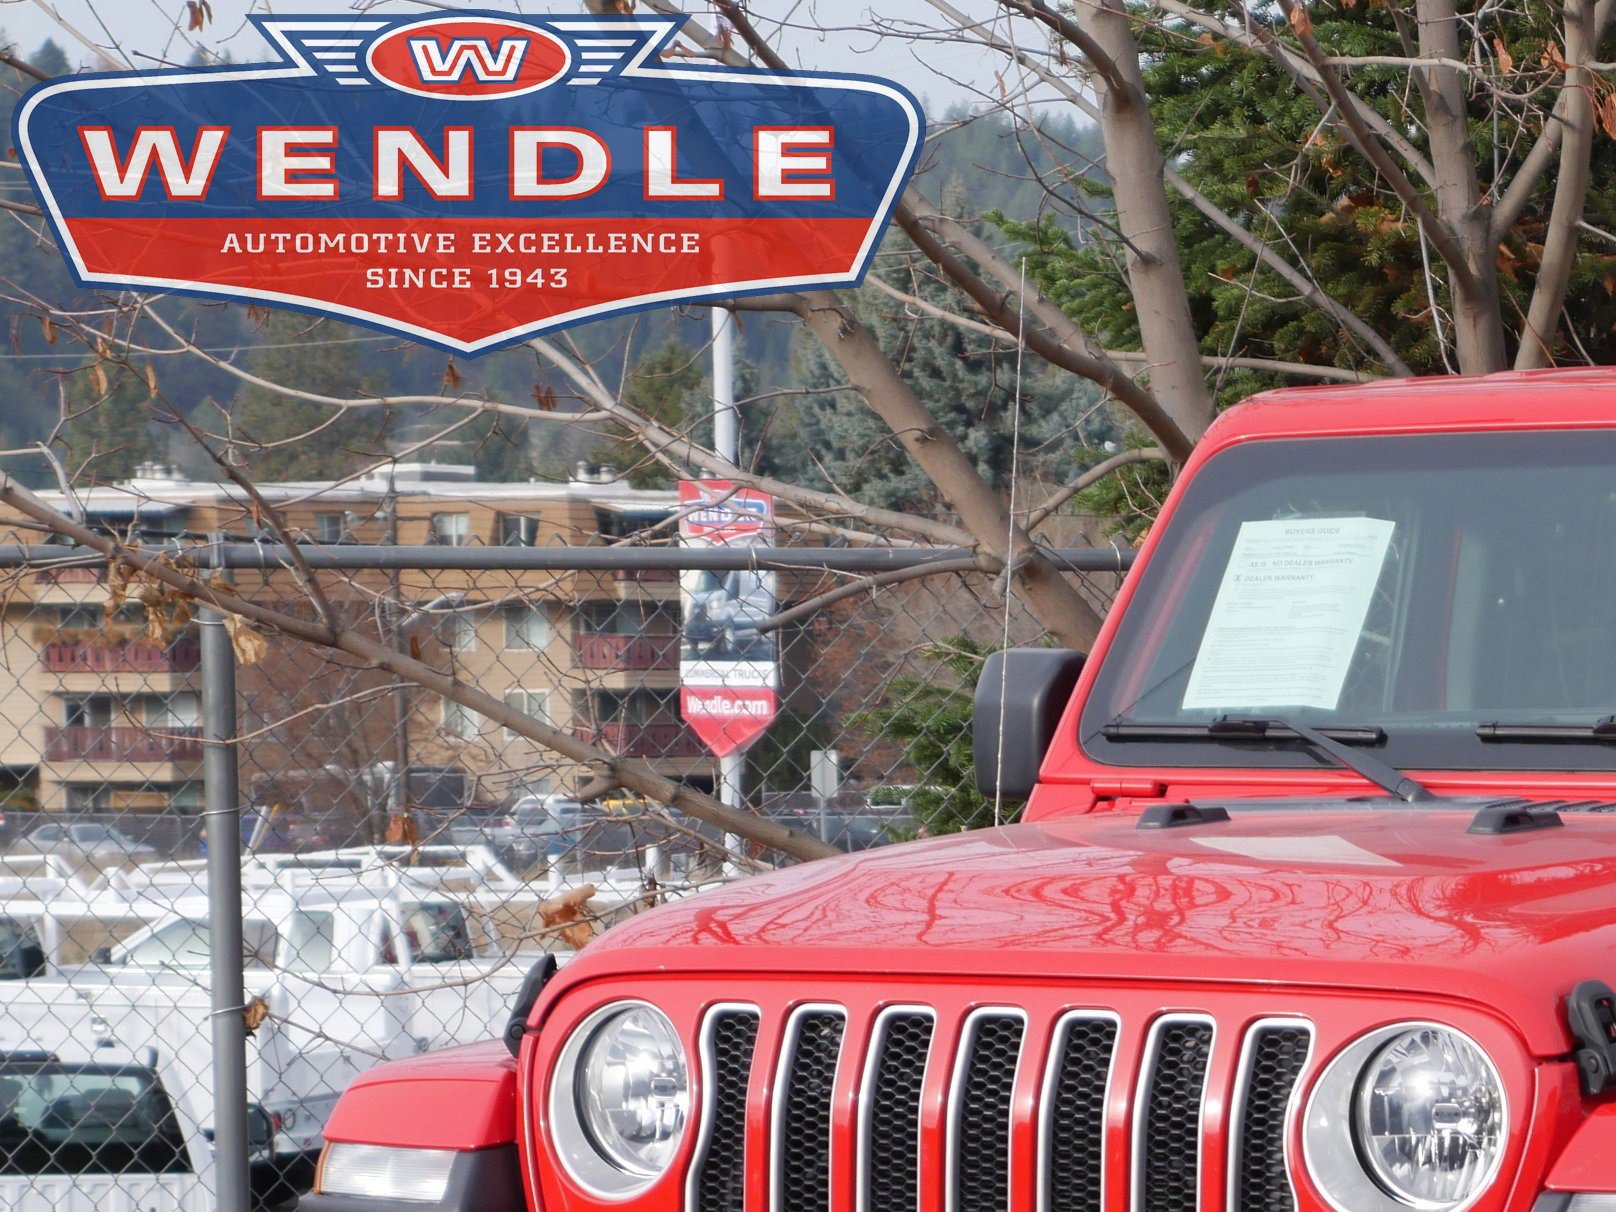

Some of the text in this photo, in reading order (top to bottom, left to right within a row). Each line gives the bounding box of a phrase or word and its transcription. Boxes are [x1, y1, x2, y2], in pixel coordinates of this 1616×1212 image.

[687, 507, 760, 522] WENDE
[1317, 527, 1341, 535] GUIDE
[686, 696, 768, 714] Wendle.com
